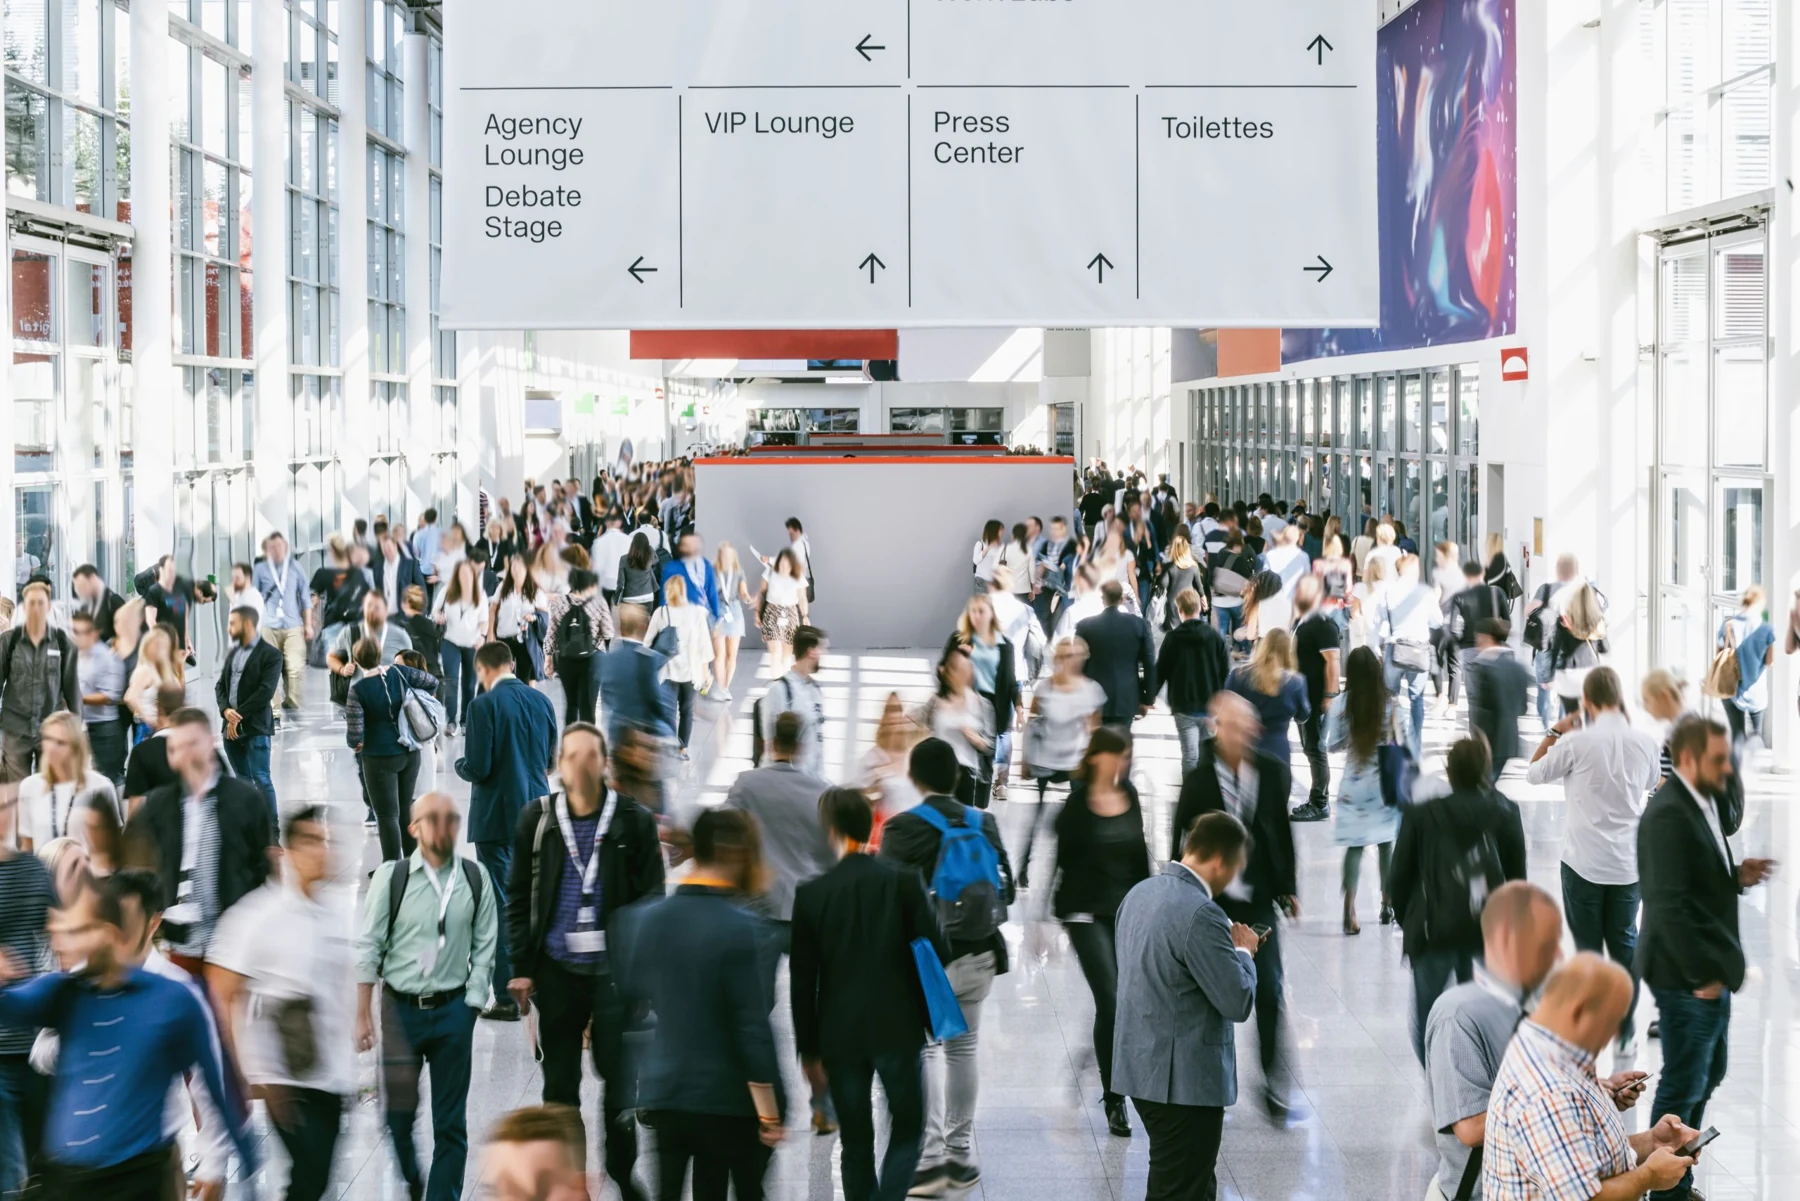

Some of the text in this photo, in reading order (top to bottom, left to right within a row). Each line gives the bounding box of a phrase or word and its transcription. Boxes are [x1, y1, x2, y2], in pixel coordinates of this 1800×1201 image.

[484, 113, 583, 141] Agency
[704, 111, 855, 139] VIP Lounge
[934, 111, 1010, 133] Press
[1161, 115, 1274, 139] Toilettes
[485, 144, 584, 171] Lounge
[934, 141, 1025, 164] Center
[485, 184, 582, 208] Debate
[485, 215, 563, 244] Stage
